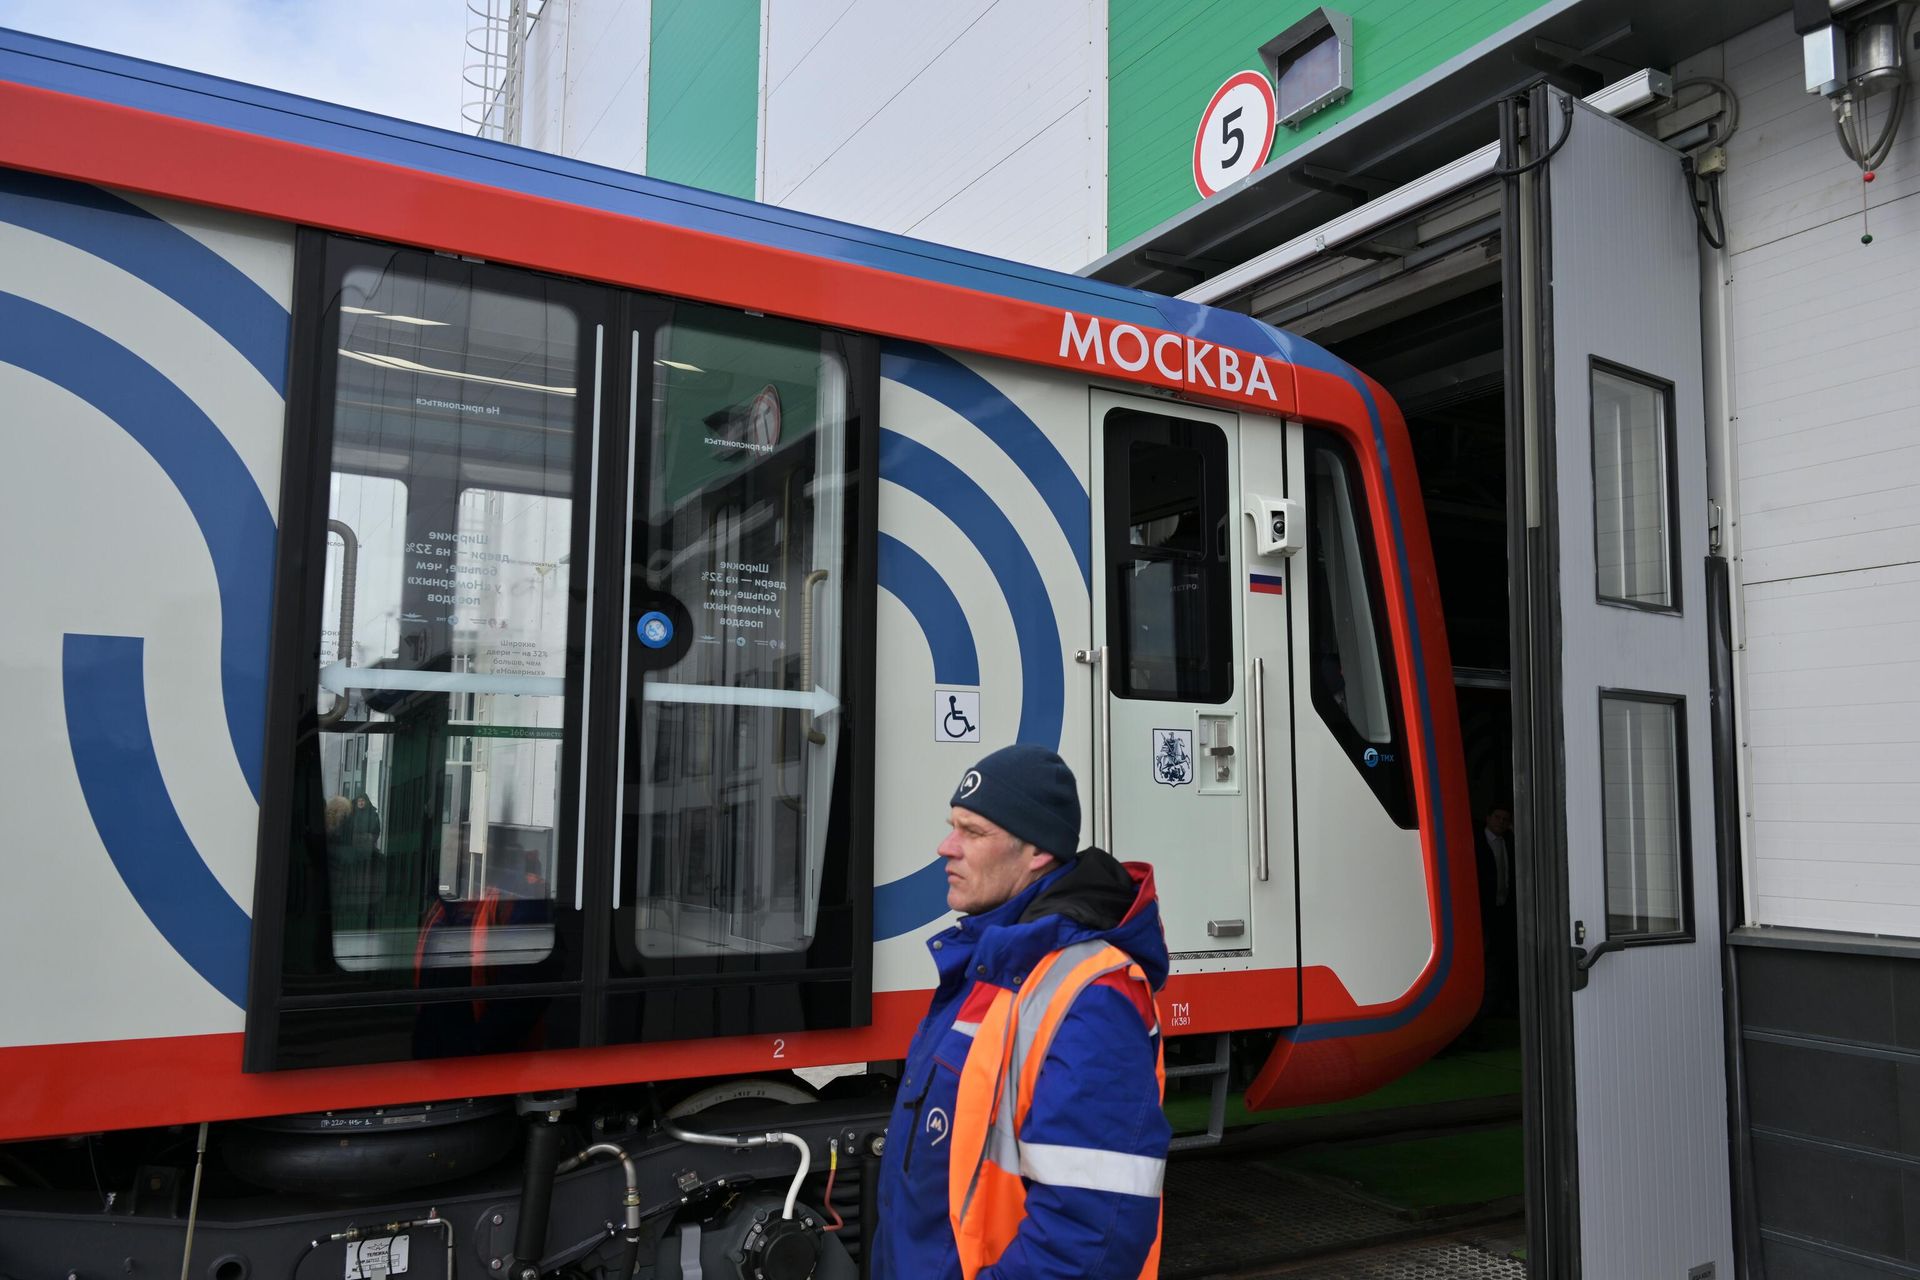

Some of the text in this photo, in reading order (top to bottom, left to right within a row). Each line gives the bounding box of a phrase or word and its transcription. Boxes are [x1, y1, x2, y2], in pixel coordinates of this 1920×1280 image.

[1221, 106, 1245, 169] 5
[1058, 311, 1278, 402] МОСКВА
[772, 1038, 785, 1059] 2
